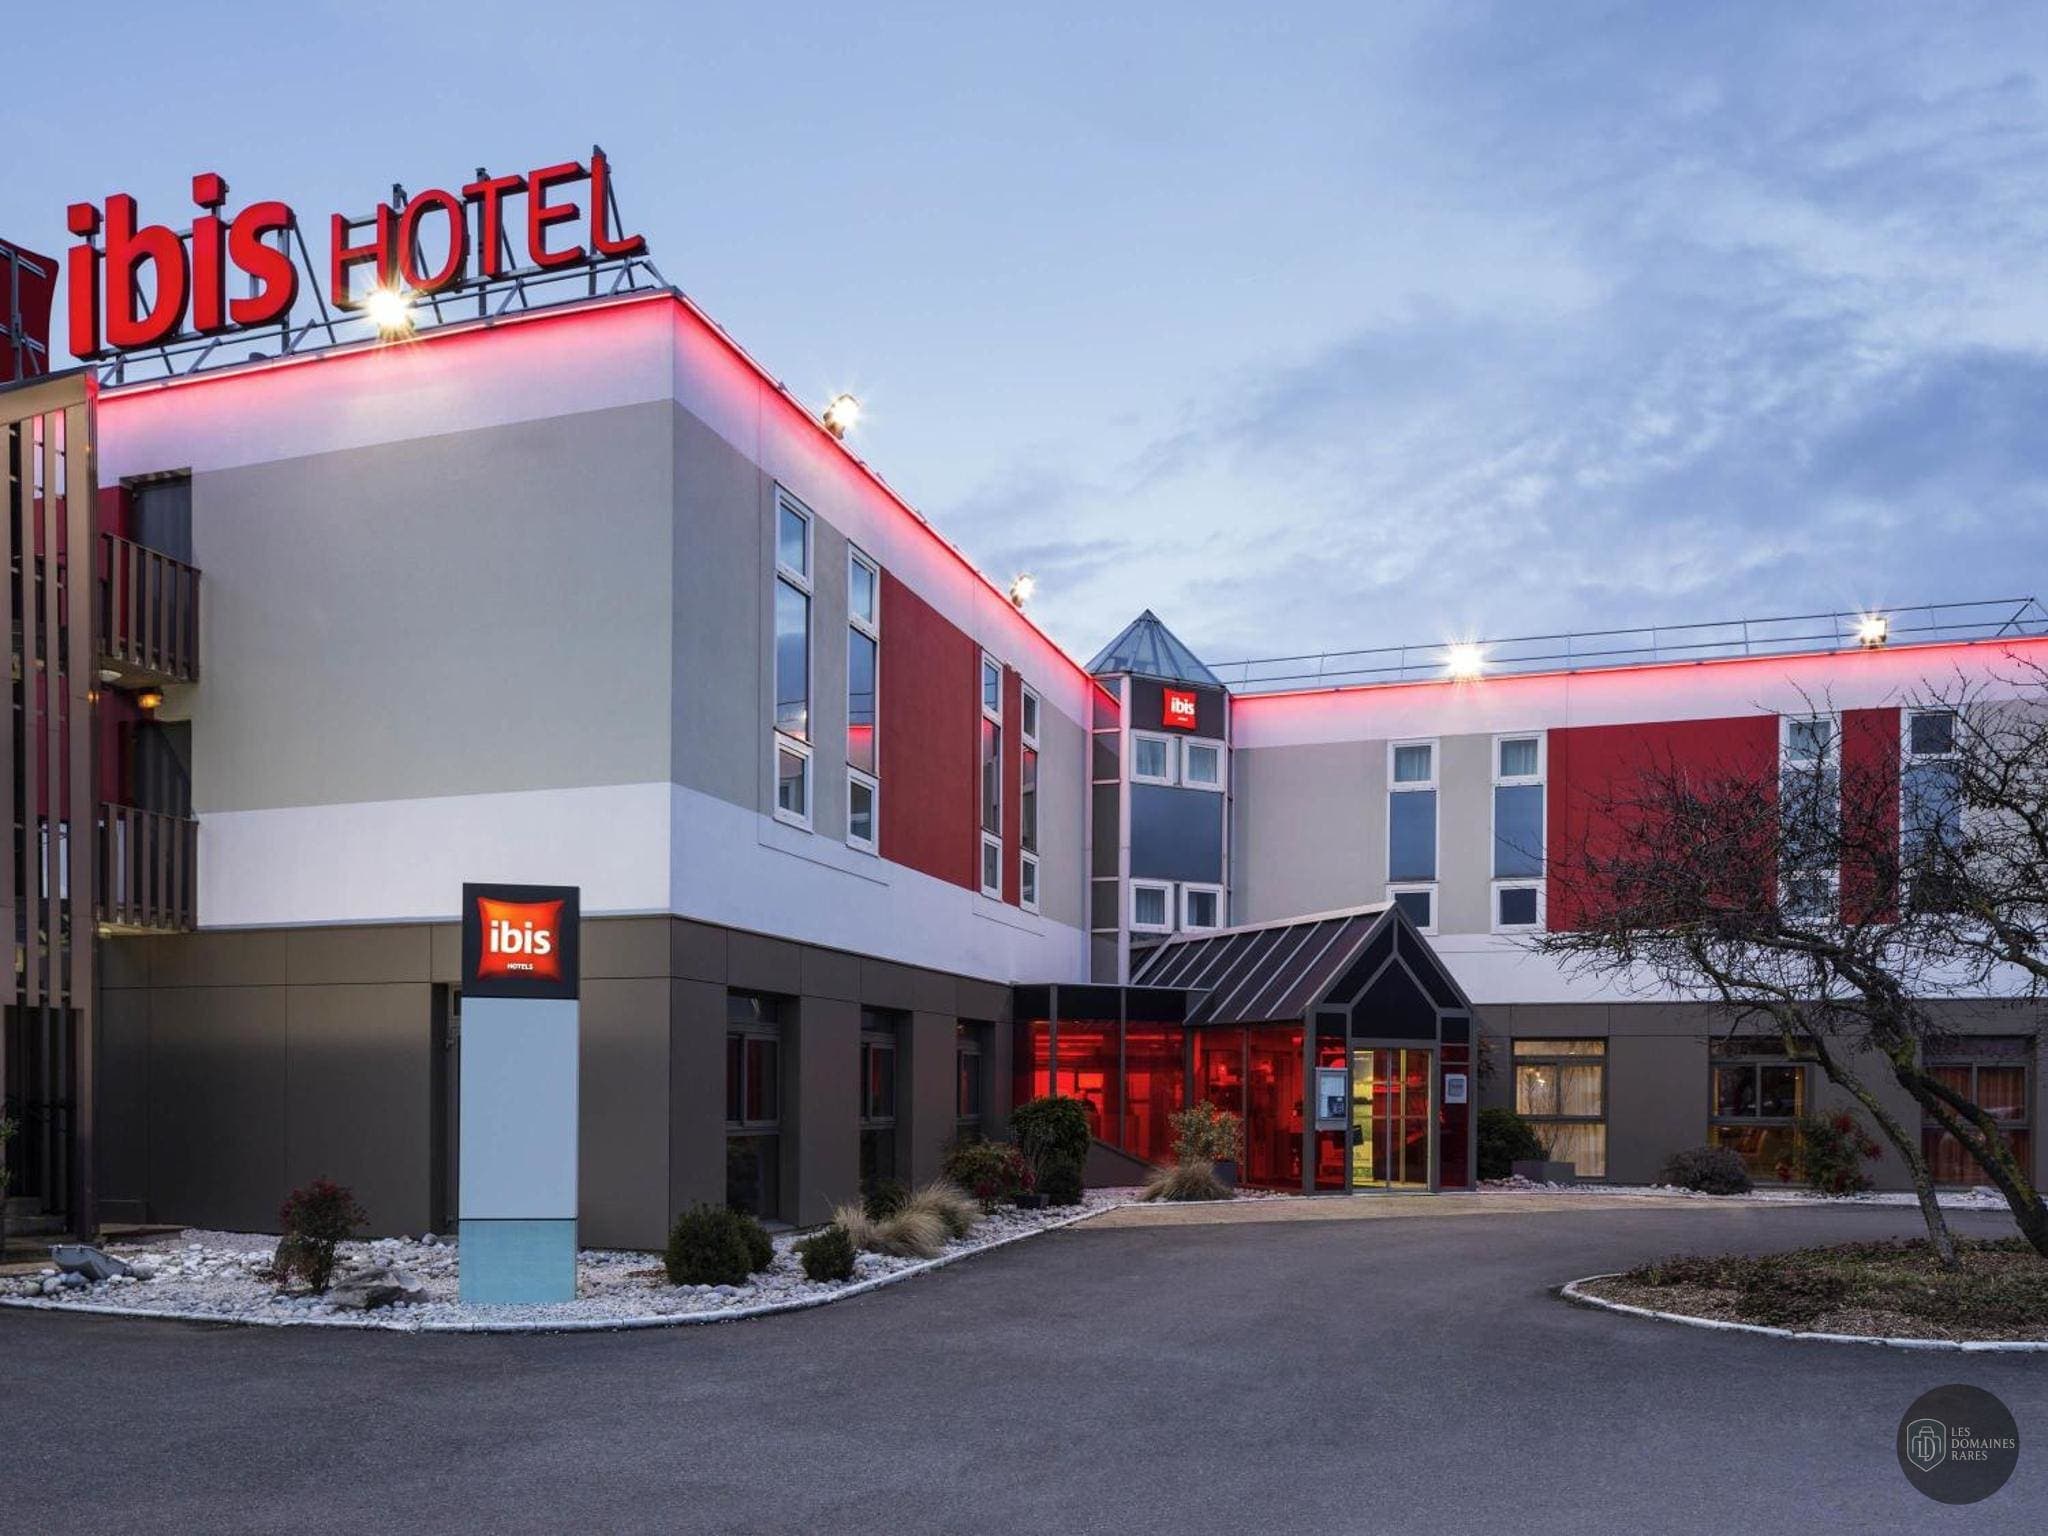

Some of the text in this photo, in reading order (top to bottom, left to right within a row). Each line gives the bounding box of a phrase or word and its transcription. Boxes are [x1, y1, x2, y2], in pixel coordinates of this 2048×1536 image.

[67, 154, 646, 360] ibis HOTEL
[1171, 697, 1195, 715] ibis
[490, 919, 551, 955] ibis
